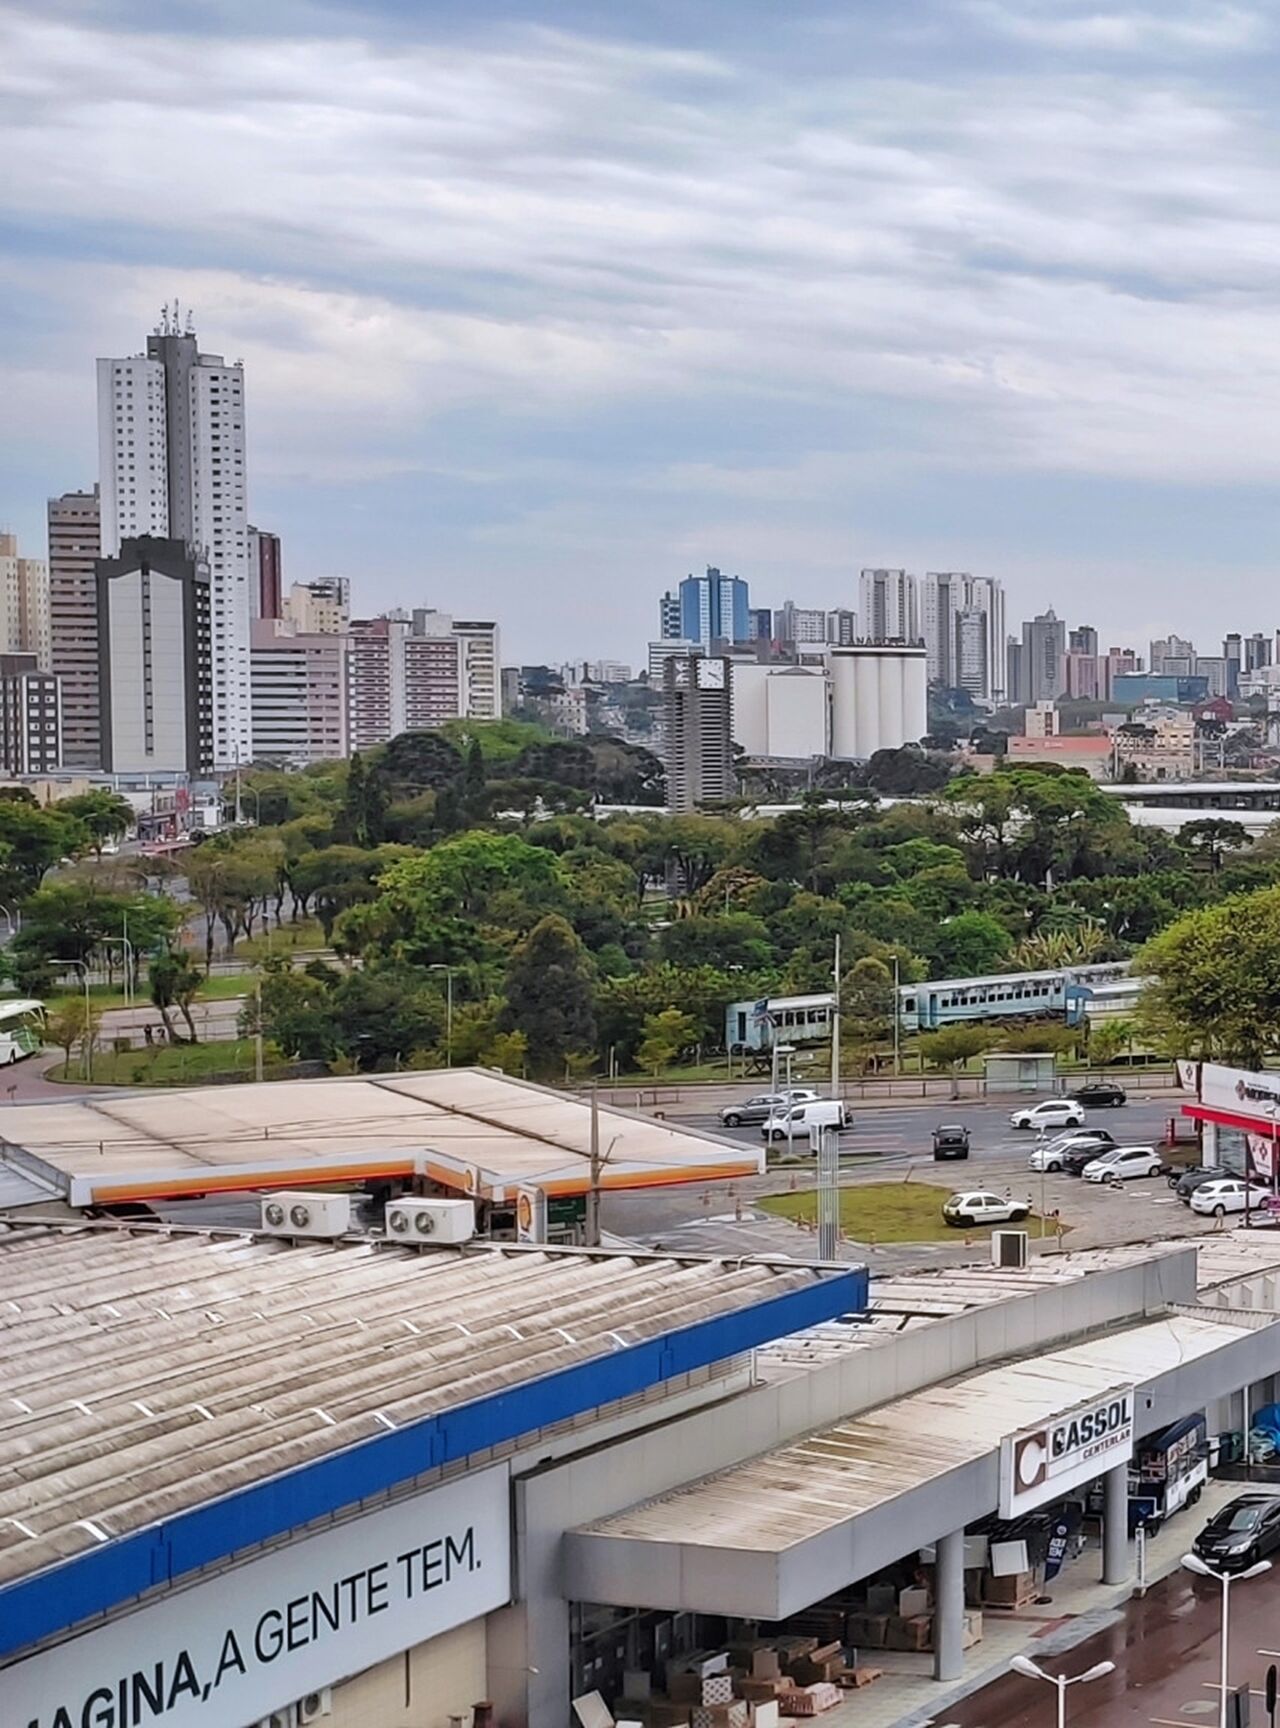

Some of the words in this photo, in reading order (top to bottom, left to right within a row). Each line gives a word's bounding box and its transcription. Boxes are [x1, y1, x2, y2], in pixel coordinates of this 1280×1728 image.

[1052, 1398, 1131, 1457] CASSOL
[254, 1562, 389, 1663] GENTE
[397, 1526, 481, 1599] TEM.
